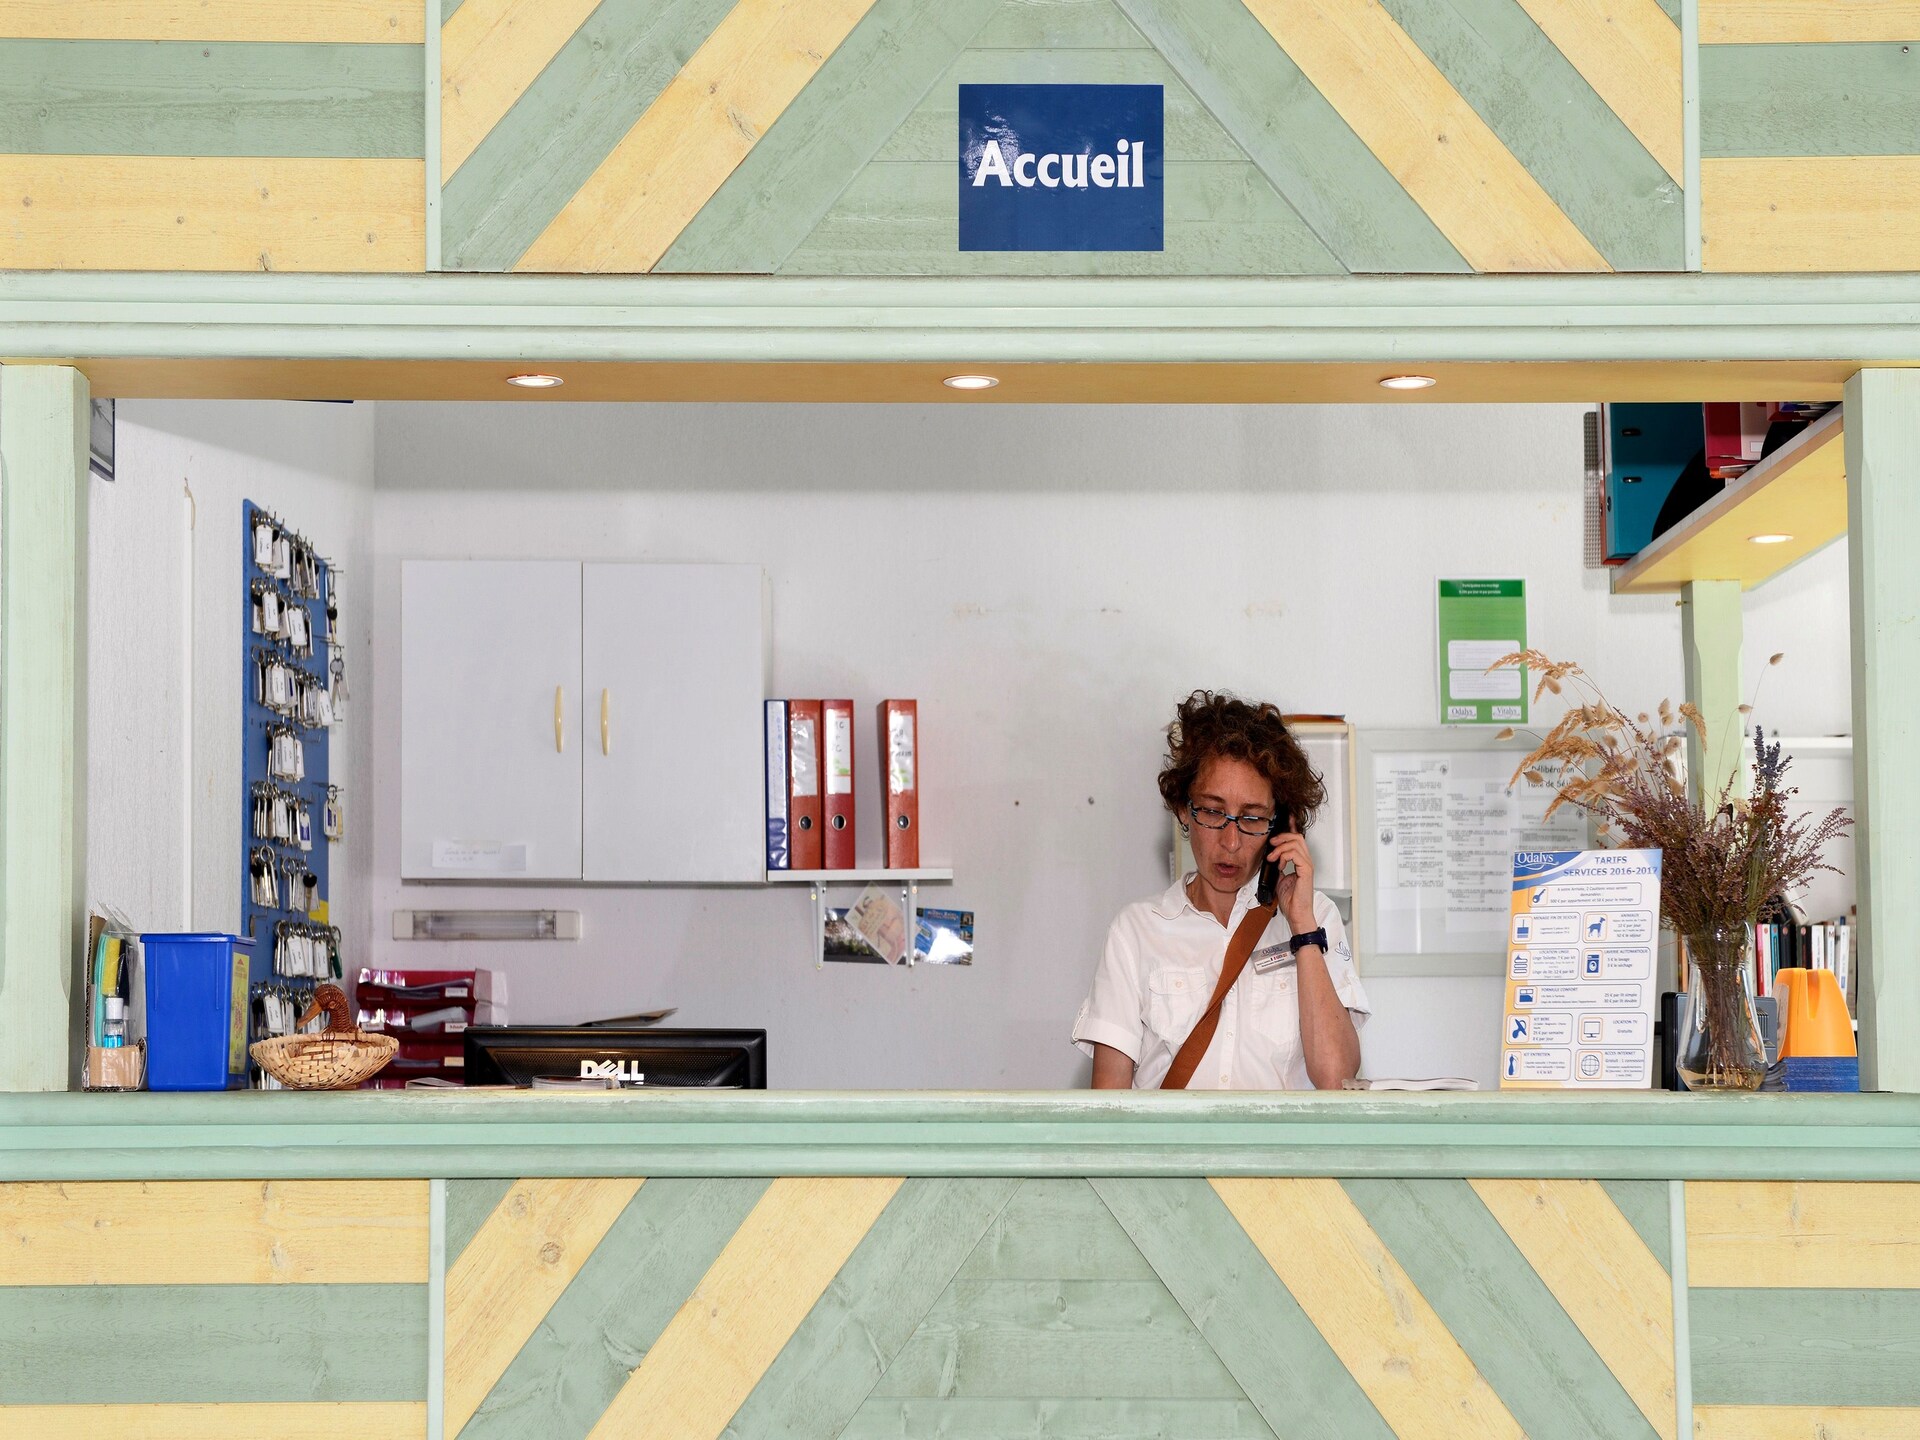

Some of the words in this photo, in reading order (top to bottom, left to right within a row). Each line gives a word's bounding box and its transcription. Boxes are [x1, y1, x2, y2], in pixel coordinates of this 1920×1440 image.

[972, 138, 1144, 188] Accueil
[1517, 852, 1554, 865] Odalys
[1594, 856, 1628, 864] TARIFS
[1564, 868, 1608, 876] SERVICES
[1610, 866, 1658, 876] 2016-2017
[580, 1059, 644, 1080] DELL
